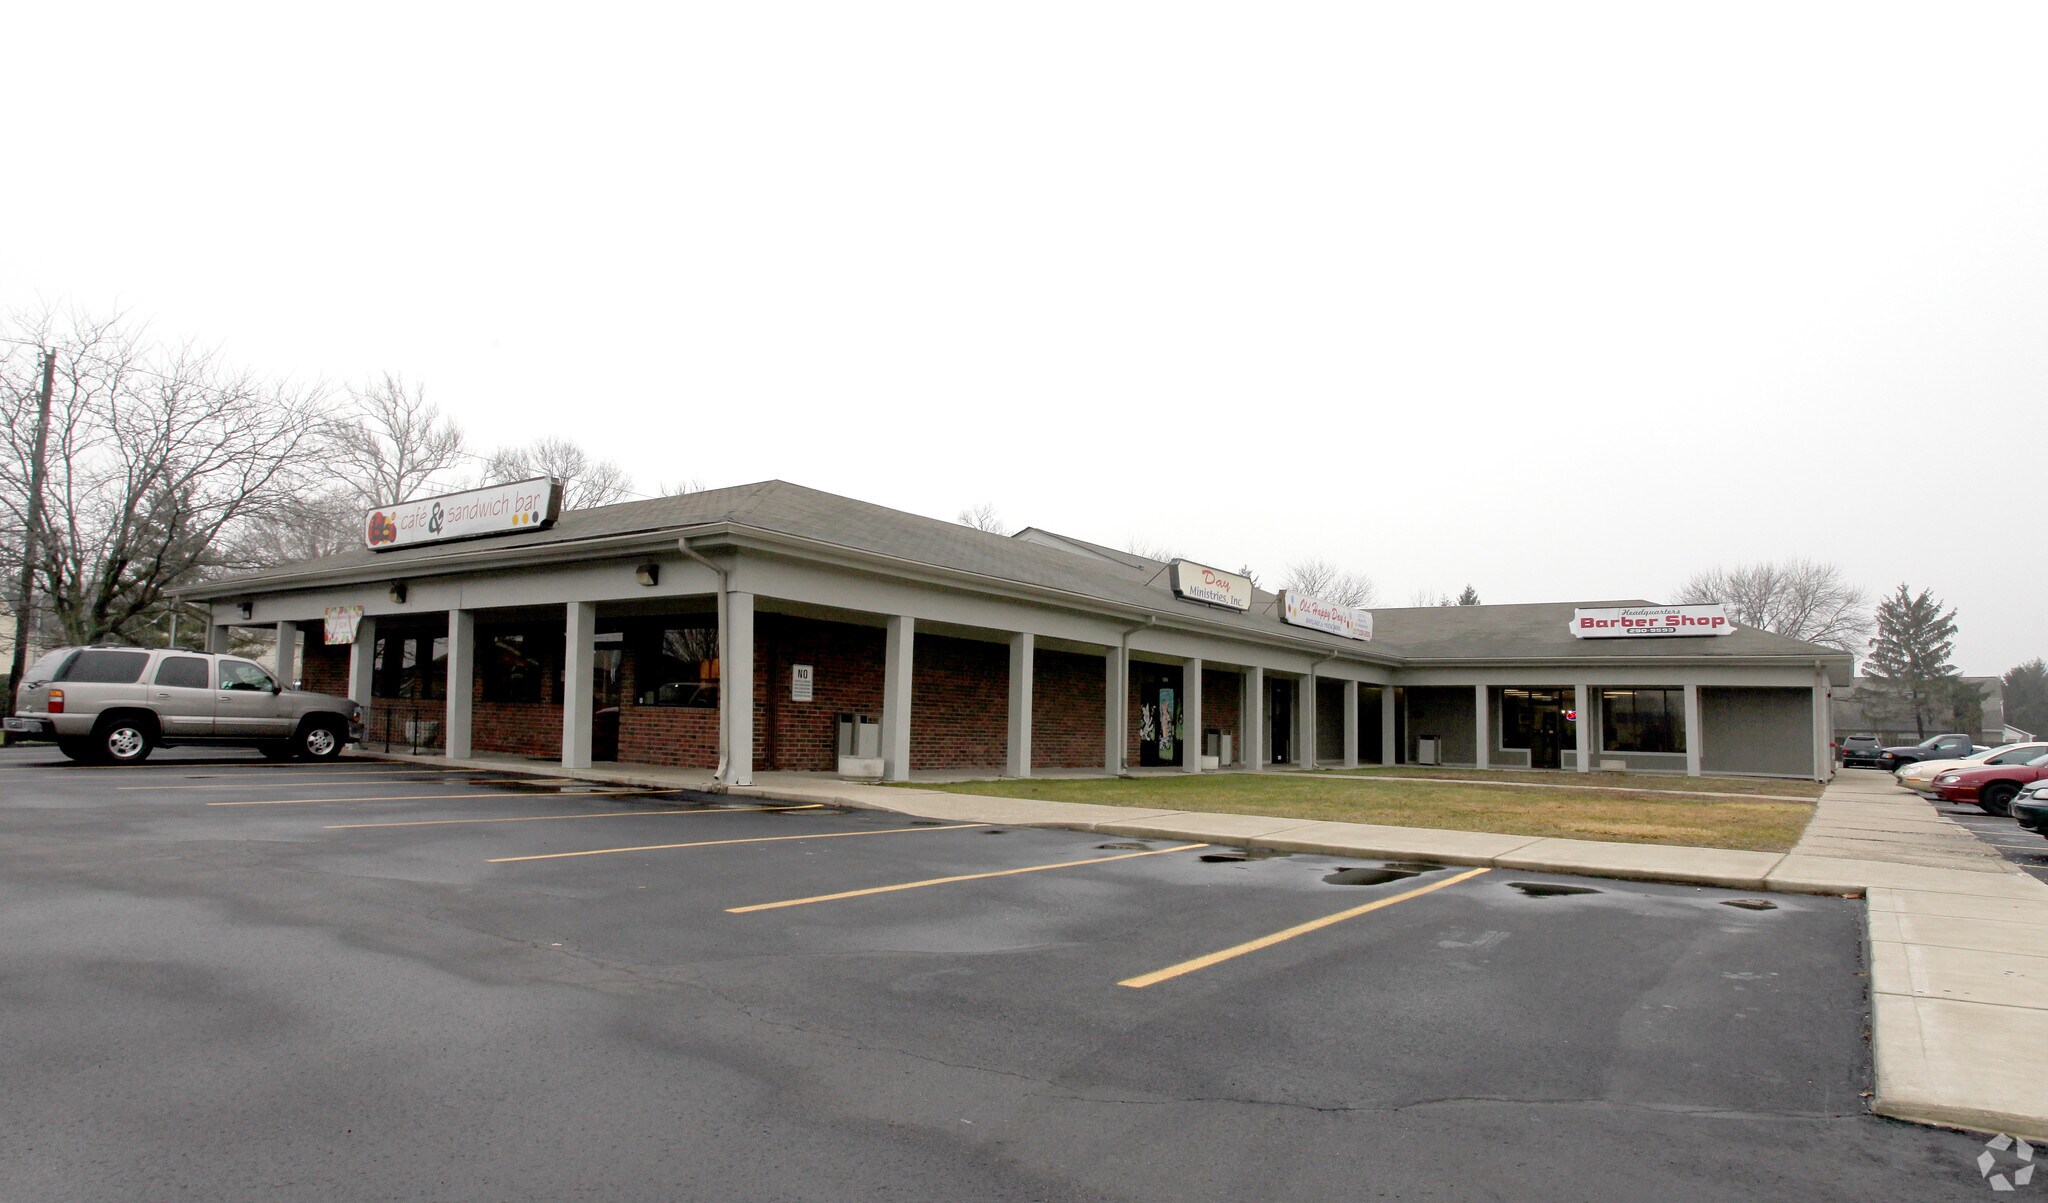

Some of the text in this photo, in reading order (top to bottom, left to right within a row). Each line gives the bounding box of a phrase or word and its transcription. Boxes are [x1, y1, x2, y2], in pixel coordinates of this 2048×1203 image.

[400, 505, 427, 530] café
[428, 501, 444, 536] &
[447, 492, 509, 523] sandwich
[515, 490, 541, 513] bar
[1201, 569, 1231, 593] Day
[1189, 585, 1244, 608] Ministries, Inc.
[1311, 601, 1332, 622] Happy
[1580, 615, 1725, 629] Barber Shop
[1621, 608, 1681, 617] Headquarters
[797, 669, 808, 679] NO
